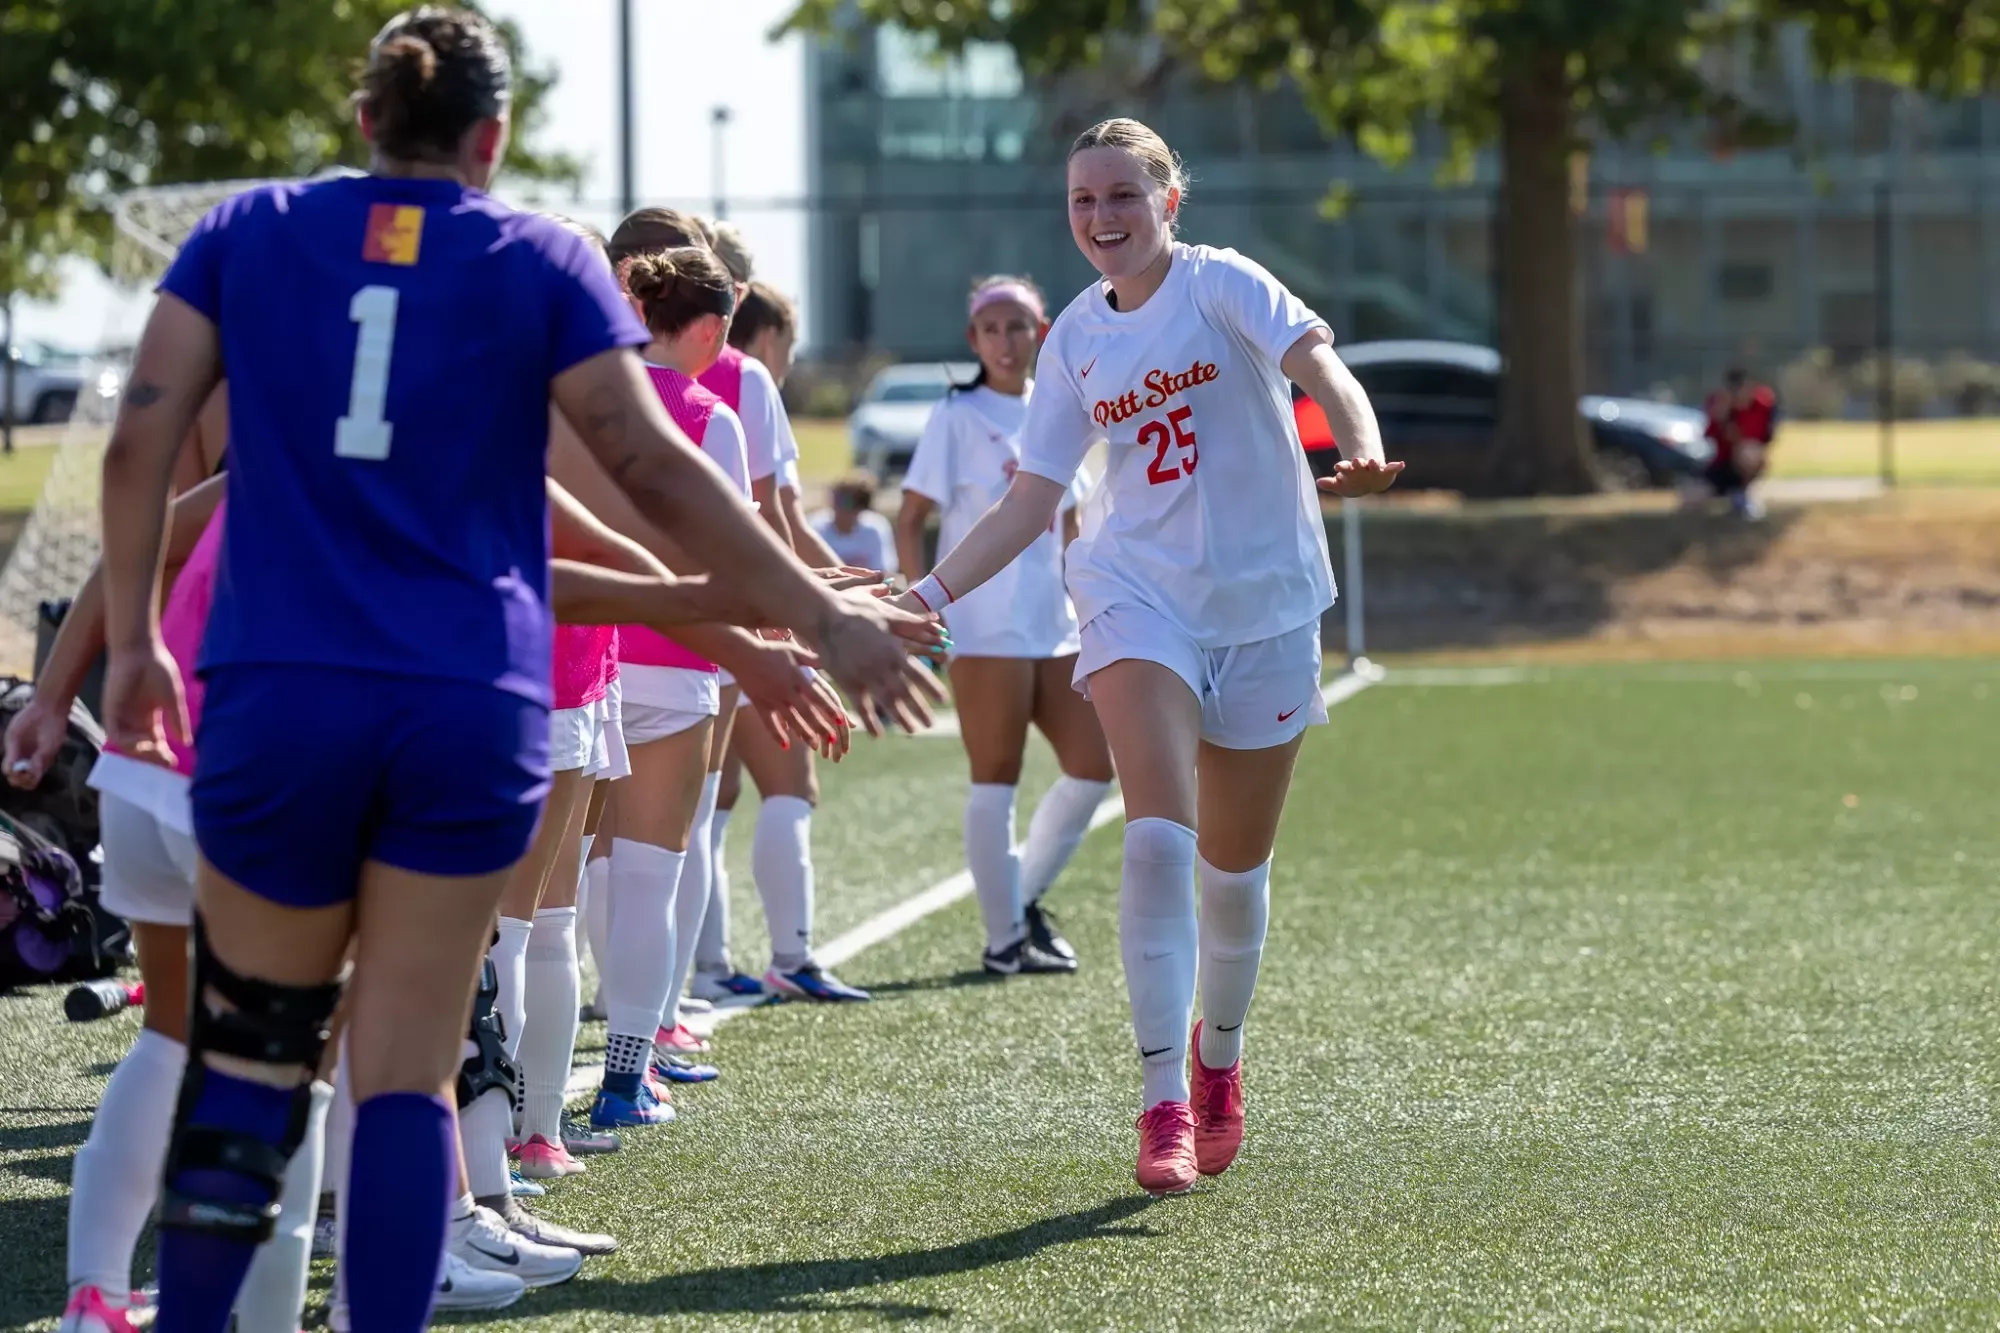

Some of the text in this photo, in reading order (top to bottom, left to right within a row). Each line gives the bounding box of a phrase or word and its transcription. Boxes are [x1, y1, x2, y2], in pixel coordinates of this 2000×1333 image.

[333, 284, 400, 461] 1
[1093, 360, 1220, 429] Pitt State
[1137, 404, 1199, 486] 25
